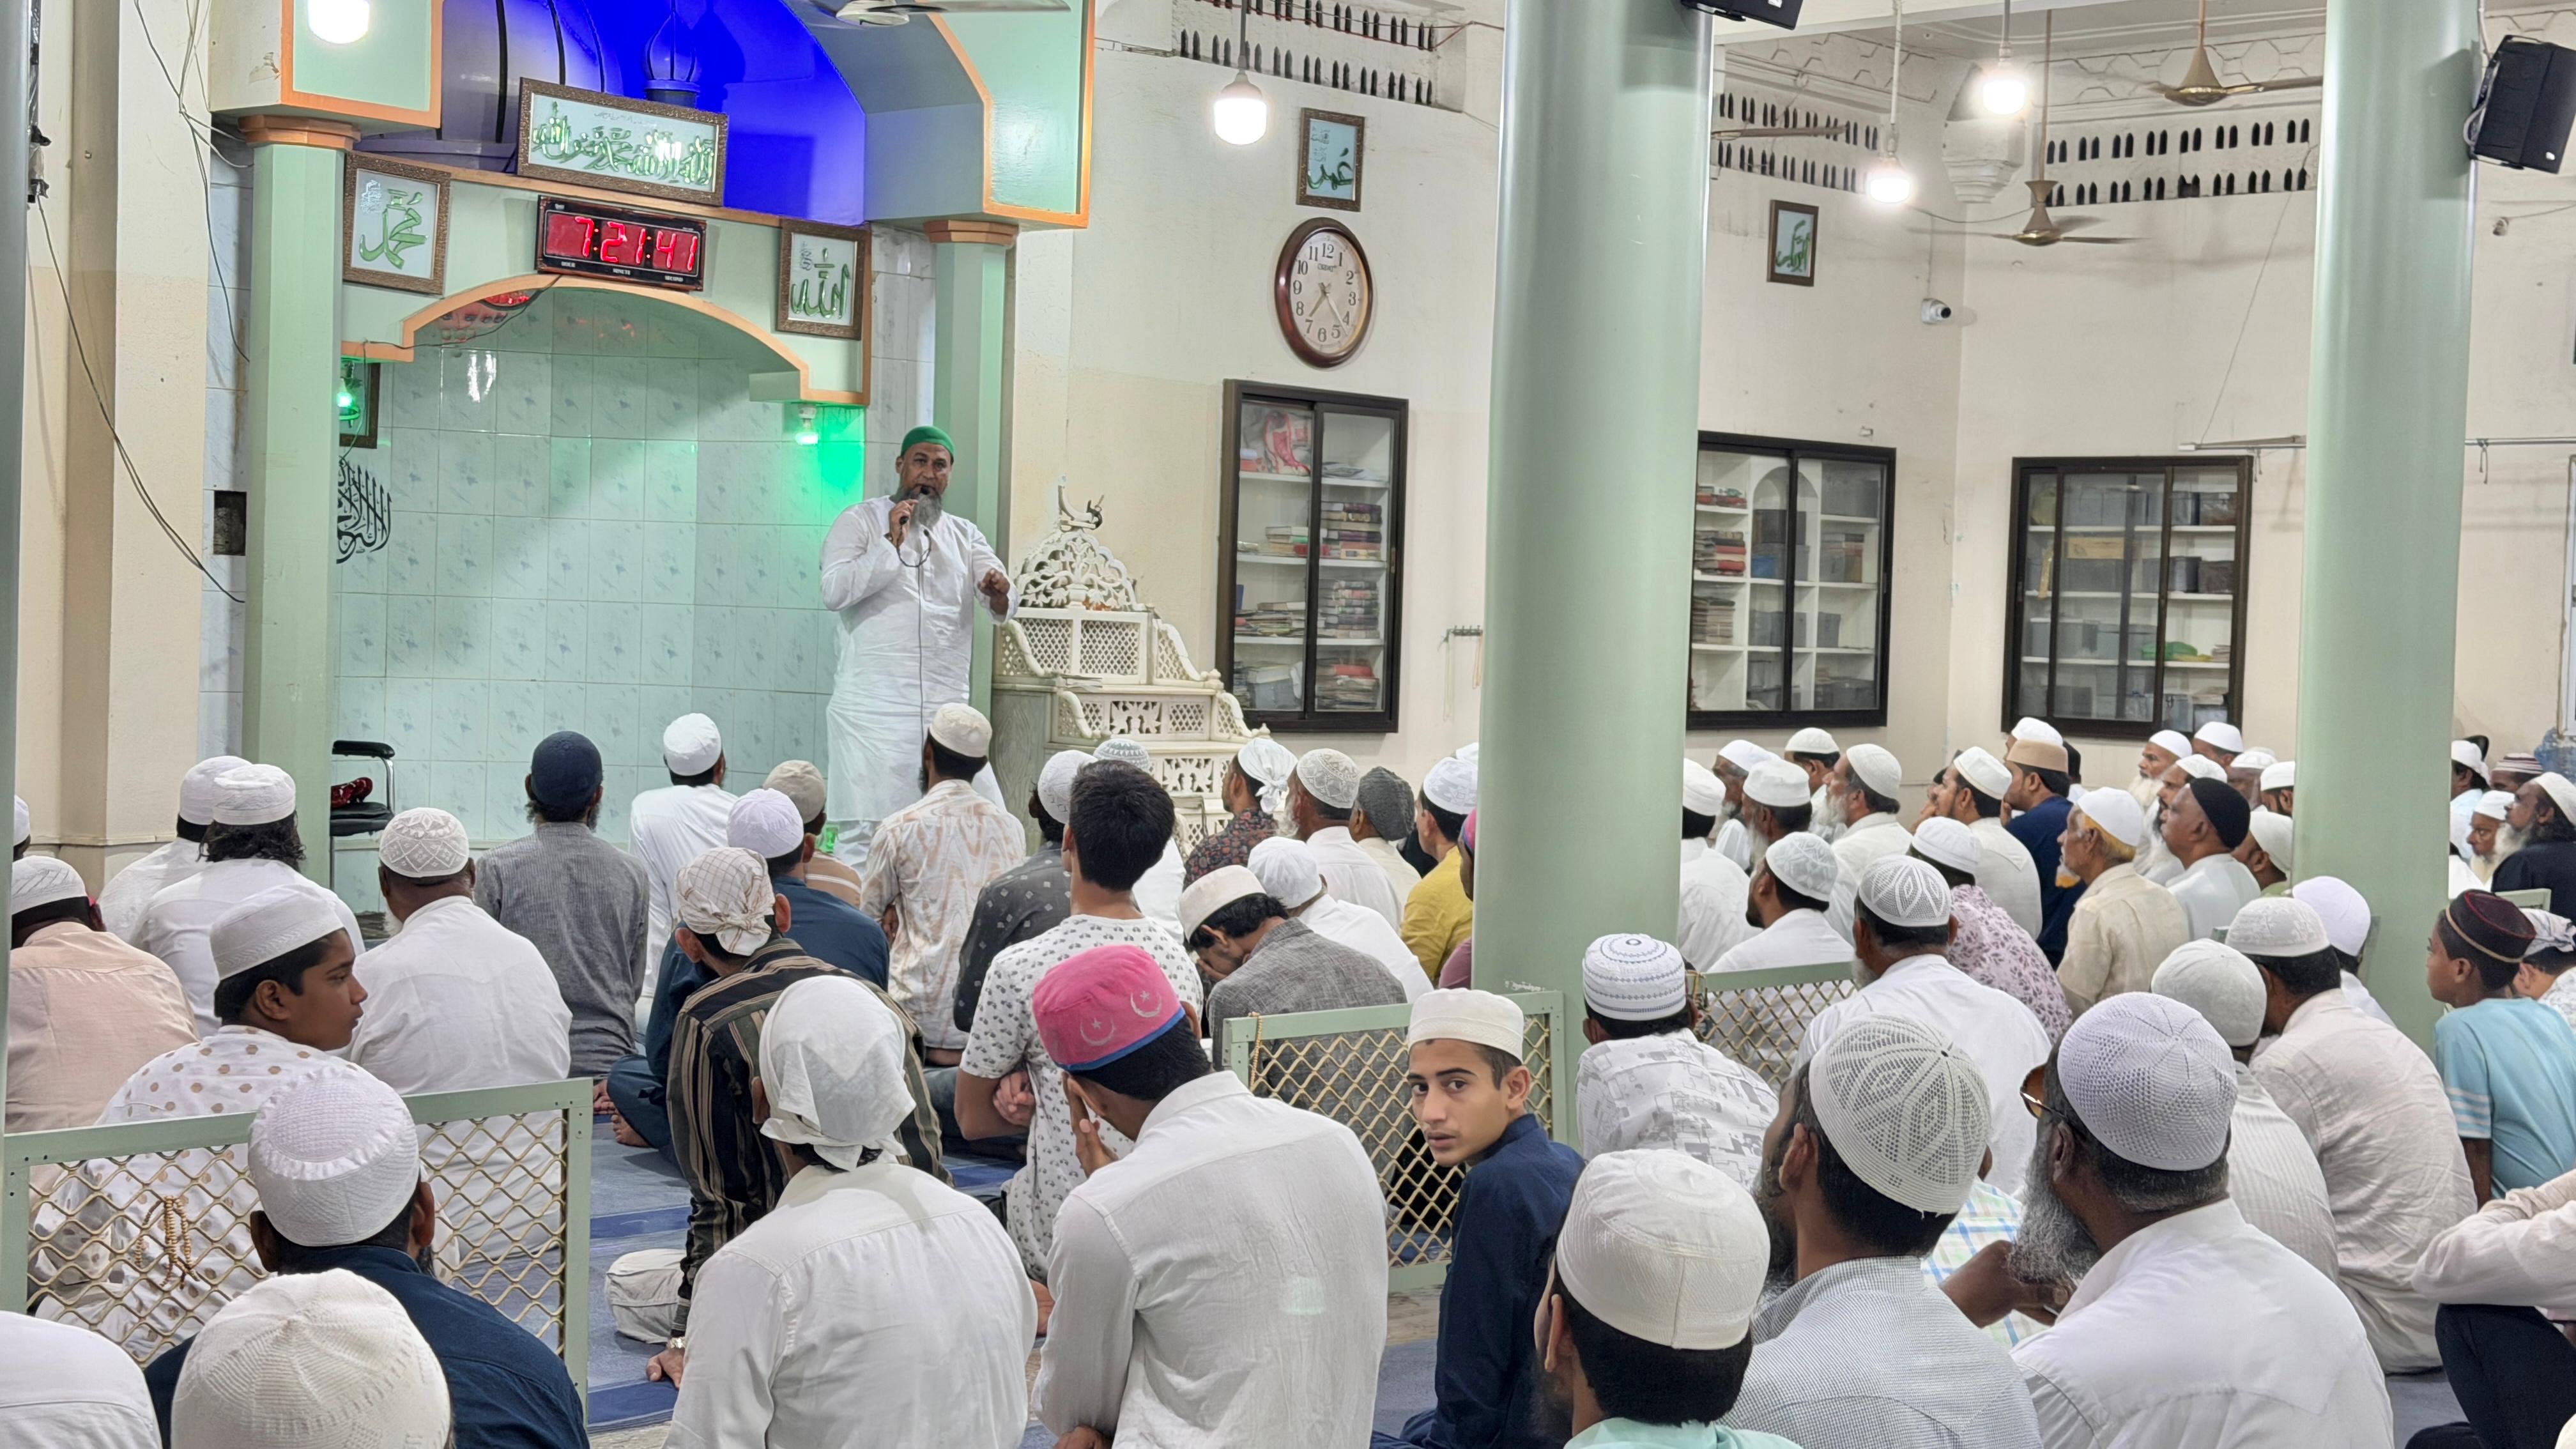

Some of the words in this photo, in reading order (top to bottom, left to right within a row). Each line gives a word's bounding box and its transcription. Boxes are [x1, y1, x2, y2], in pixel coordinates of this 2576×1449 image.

[359, 189, 428, 270] محمد
[574, 216, 698, 272] 7:21:41
[1322, 243, 1335, 259] 12
[1309, 245, 1318, 261] 11
[1338, 252, 1343, 267] 1
[1298, 260, 1308, 275] 10
[790, 247, 851, 319] الله
[1346, 270, 1354, 284] 2
[1293, 280, 1302, 295] 9
[1348, 291, 1356, 306] 3
[1296, 301, 1304, 316] 8
[1342, 310, 1350, 326] 4
[1305, 319, 1314, 334] 7
[1331, 325, 1340, 339] 5
[1317, 328, 1327, 342] 6
